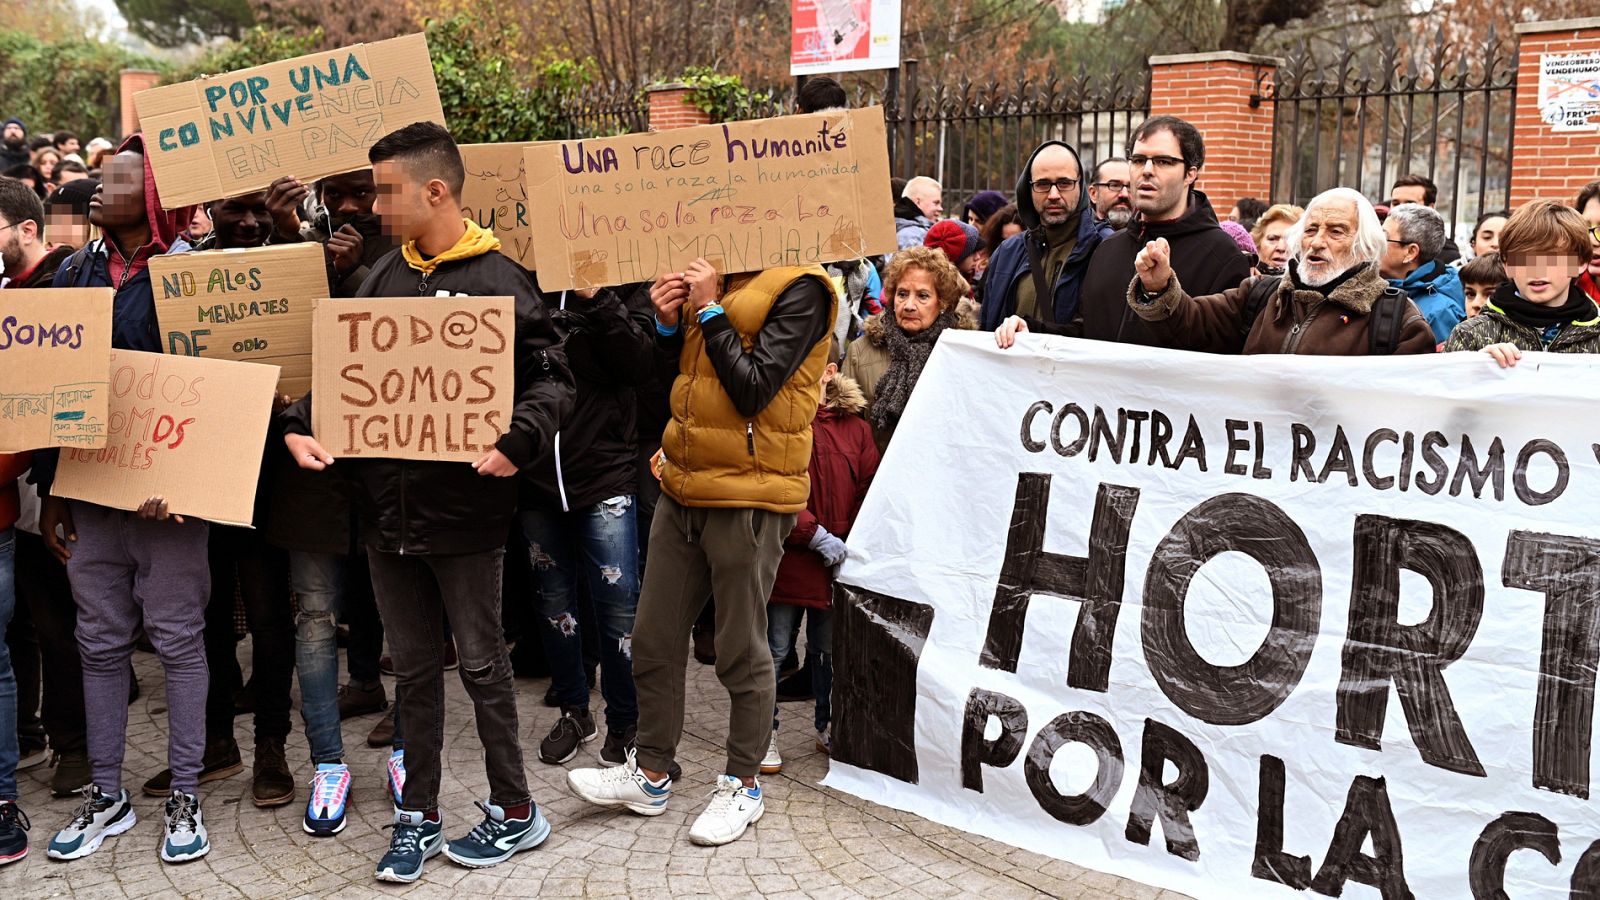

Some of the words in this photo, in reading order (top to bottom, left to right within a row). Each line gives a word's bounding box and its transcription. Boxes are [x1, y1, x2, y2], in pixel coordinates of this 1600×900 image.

[204, 75, 270, 113] POR
[288, 53, 370, 93] UNA
[1545, 66, 1600, 75] VENDEHUMO
[226, 139, 281, 180] EN
[300, 112, 384, 161] PAZ
[632, 139, 712, 171] race
[722, 119, 848, 163] humanité
[567, 182, 604, 196] una
[665, 174, 718, 188] raza
[727, 169, 746, 185] la
[757, 161, 860, 185] humanidad
[558, 200, 632, 241] Una
[639, 200, 697, 234] sola
[709, 204, 784, 225] raza
[162, 270, 198, 300] NO
[0, 315, 85, 351] SOMOS
[197, 297, 289, 324] MENSAJES
[337, 307, 507, 355] TOD@S
[168, 328, 212, 358] DE
[340, 363, 497, 408] SOMOS
[342, 409, 503, 456] IGUALES
[1019, 399, 1209, 472] CONTRA
[1223, 418, 1273, 479] EL
[1289, 422, 1571, 507] RACISMO
[960, 686, 1210, 862] POR
[1250, 753, 1417, 900] LA
